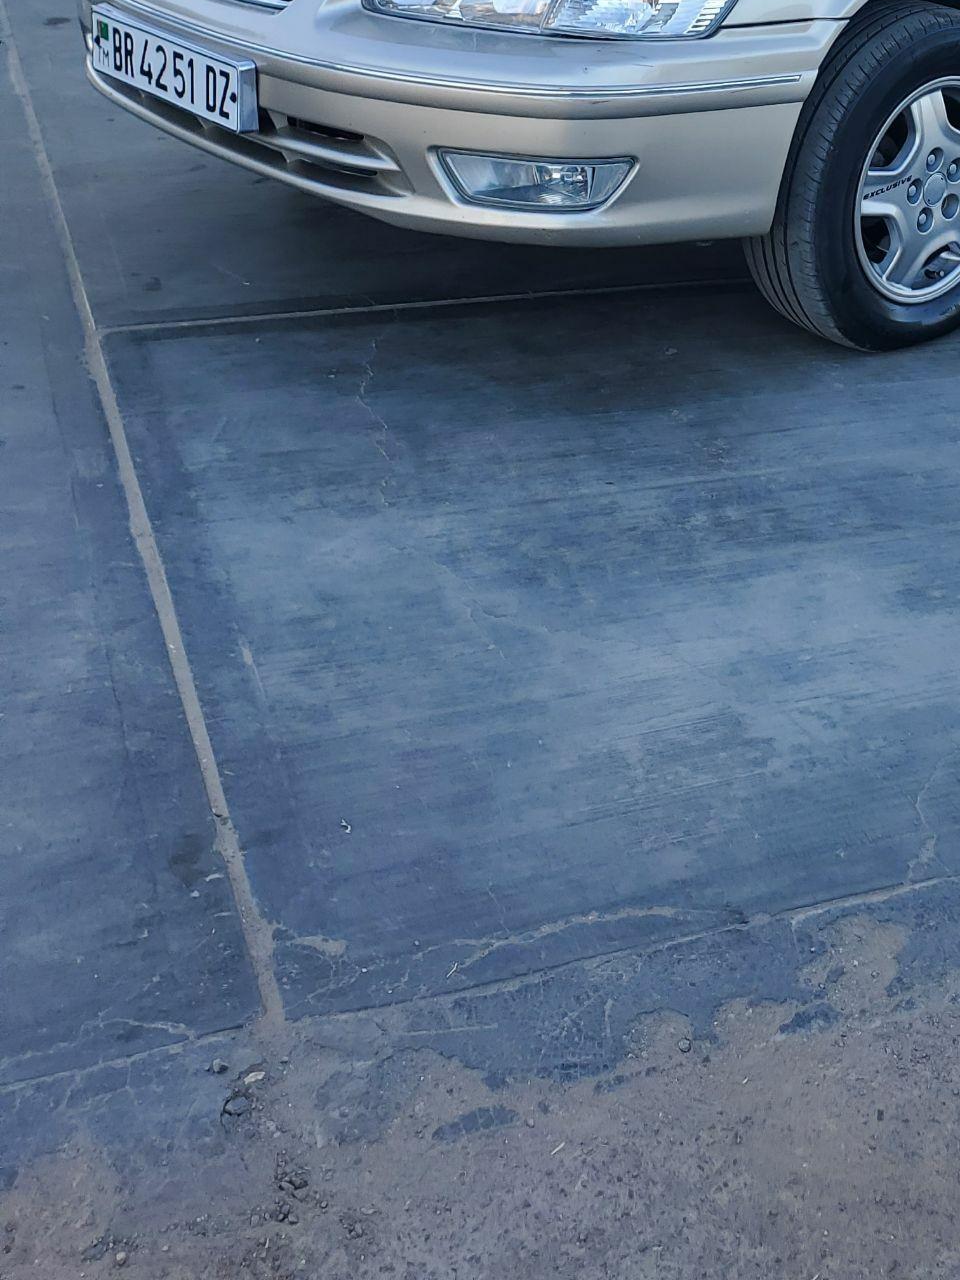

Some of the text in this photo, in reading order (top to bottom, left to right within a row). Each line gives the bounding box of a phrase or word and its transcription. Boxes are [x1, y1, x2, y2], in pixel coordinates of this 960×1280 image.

[112, 26, 231, 120] BR 4251 DZ
[862, 174, 913, 201] EXCLUSIVE
